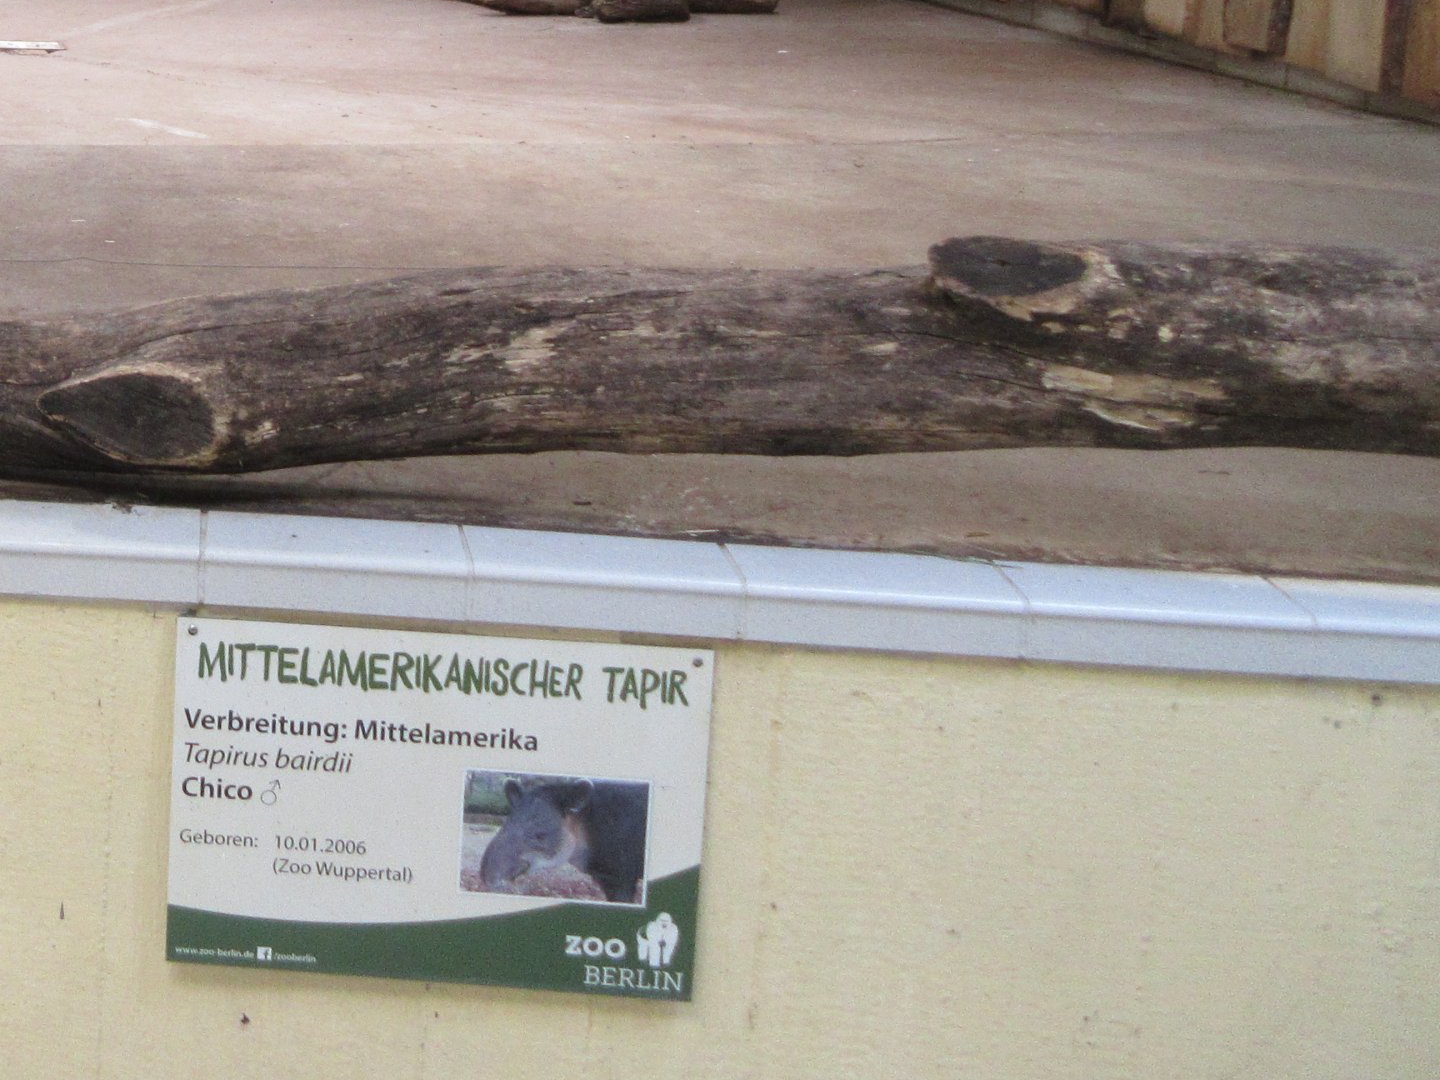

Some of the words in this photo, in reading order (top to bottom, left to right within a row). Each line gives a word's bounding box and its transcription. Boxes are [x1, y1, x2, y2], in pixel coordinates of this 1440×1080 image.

[197, 641, 583, 700] MITTELAMERIKANISCHER
[603, 666, 689, 709] TAPIR
[184, 708, 348, 743] Verbreitung:
[355, 719, 539, 752] Mittelamerika
[184, 742, 269, 771] Tapirus
[275, 748, 353, 774] bairdii
[181, 776, 253, 801] Chico
[179, 828, 258, 848] Geboren:
[274, 835, 367, 855] 10.01.2006
[272, 857, 311, 875] (Zoo
[315, 860, 413, 884] Wuppertal)
[584, 965, 684, 991] BERLIN
